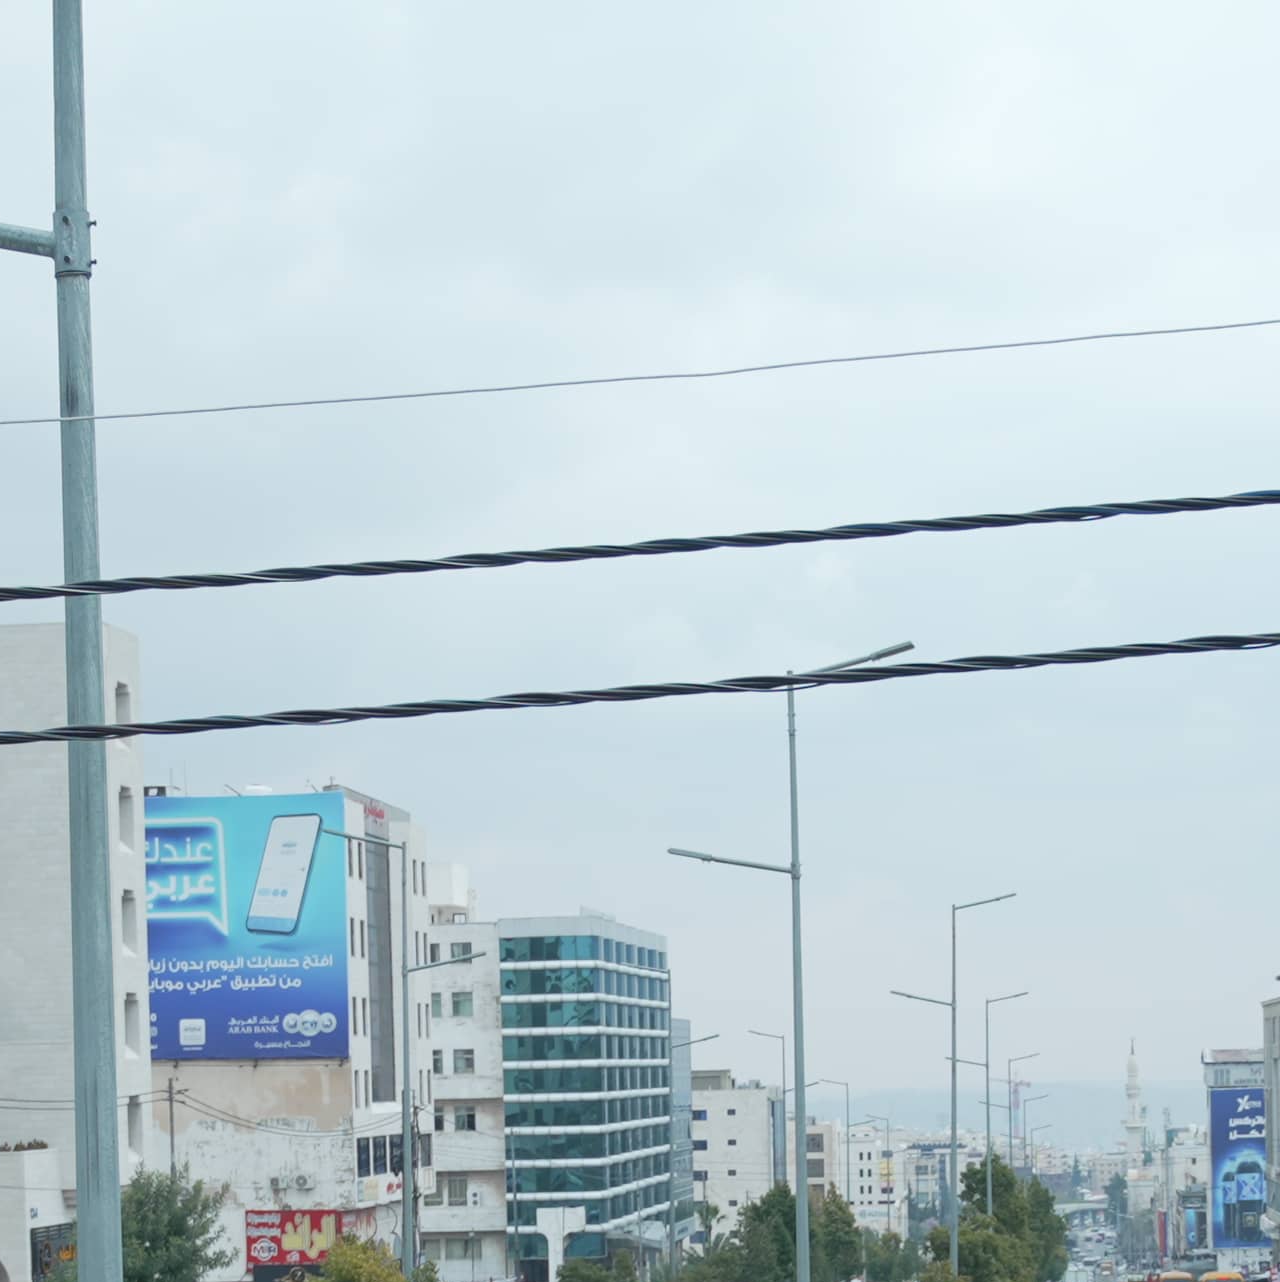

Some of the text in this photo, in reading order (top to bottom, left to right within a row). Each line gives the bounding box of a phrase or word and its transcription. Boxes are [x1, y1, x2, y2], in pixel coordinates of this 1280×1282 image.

[169, 957, 205, 973] بدون
[206, 955, 244, 973] اليوم
[247, 955, 300, 970] حسابك
[302, 954, 334, 970] افتح
[230, 973, 277, 991] تطبيق
[278, 974, 302, 989] من
[228, 1025, 253, 1034] ARAB
[253, 1024, 279, 1033] BANK
[280, 1211, 337, 1260] الرائد
